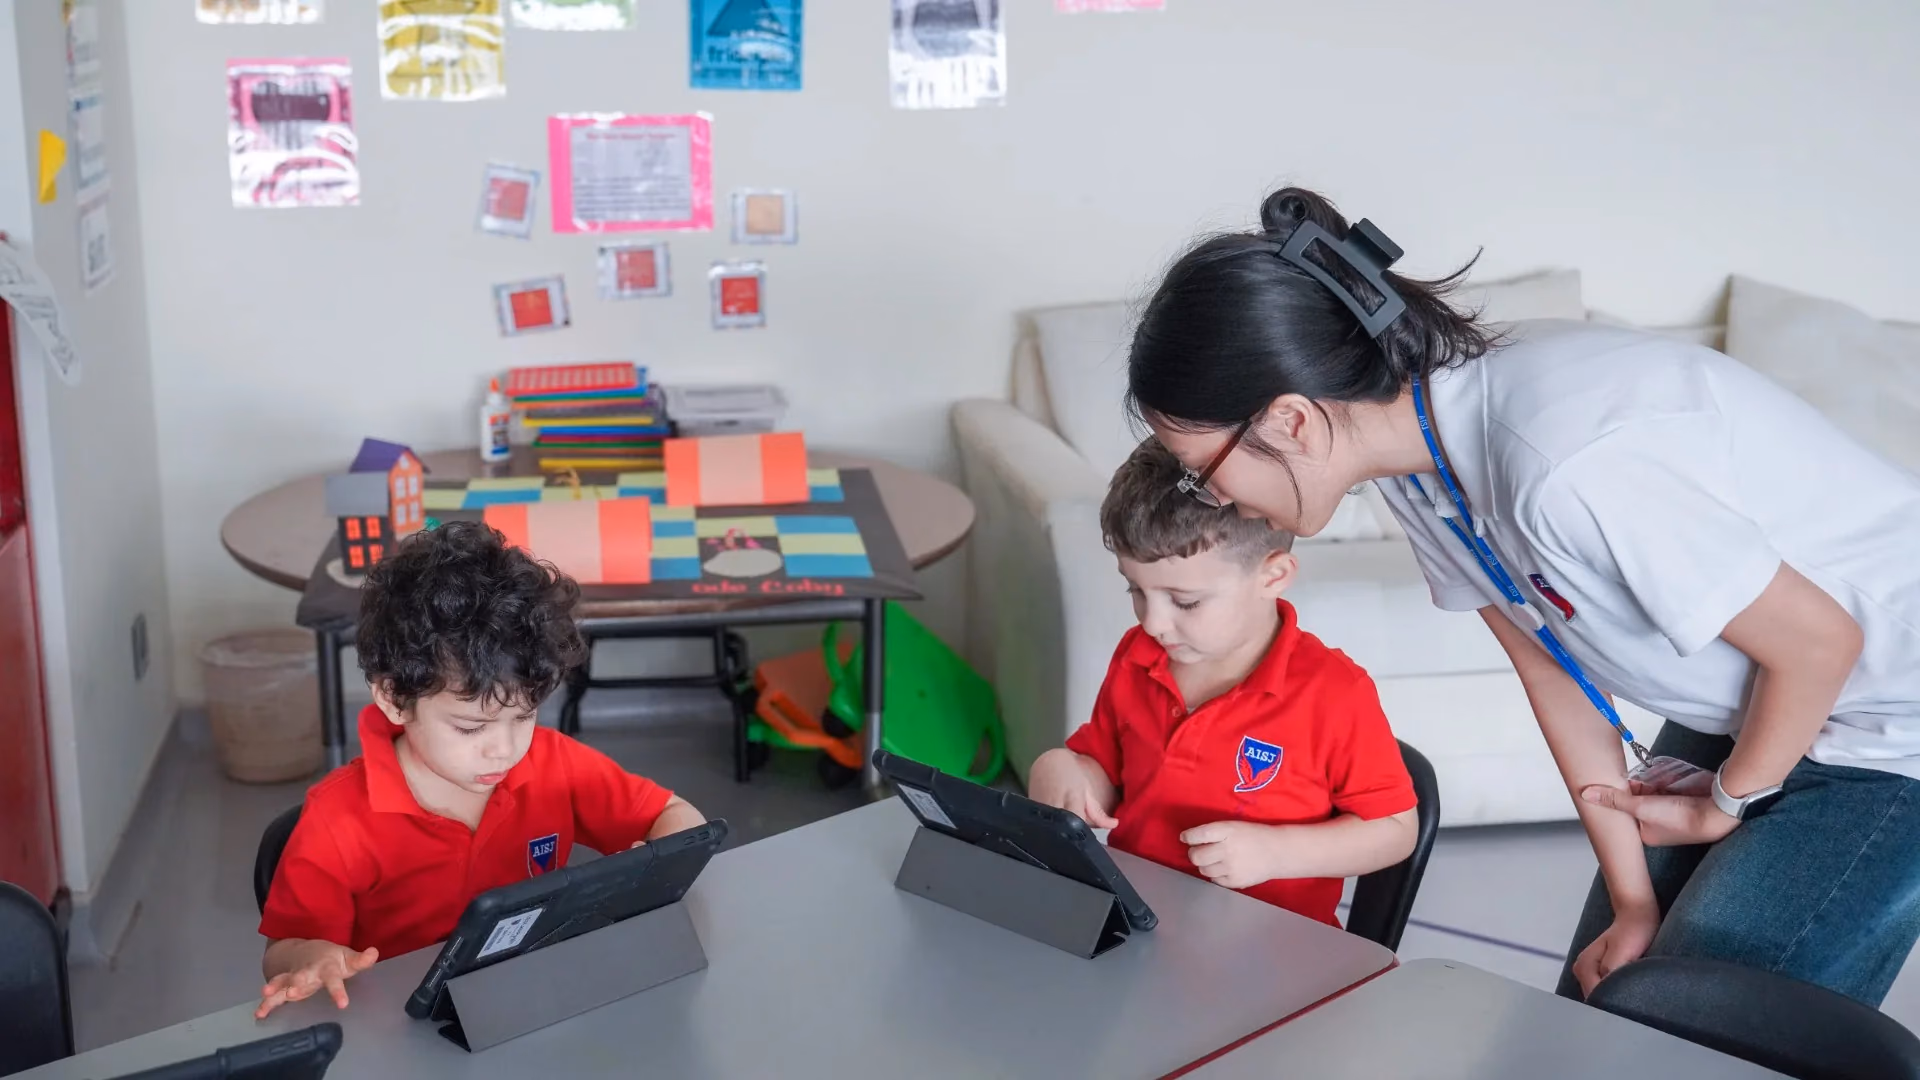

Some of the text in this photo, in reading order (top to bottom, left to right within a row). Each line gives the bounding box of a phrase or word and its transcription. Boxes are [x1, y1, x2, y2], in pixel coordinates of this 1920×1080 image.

[1418, 415, 1429, 430] AISJ
[1244, 746, 1277, 763] AISJ
[532, 841, 555, 858] AISJ
